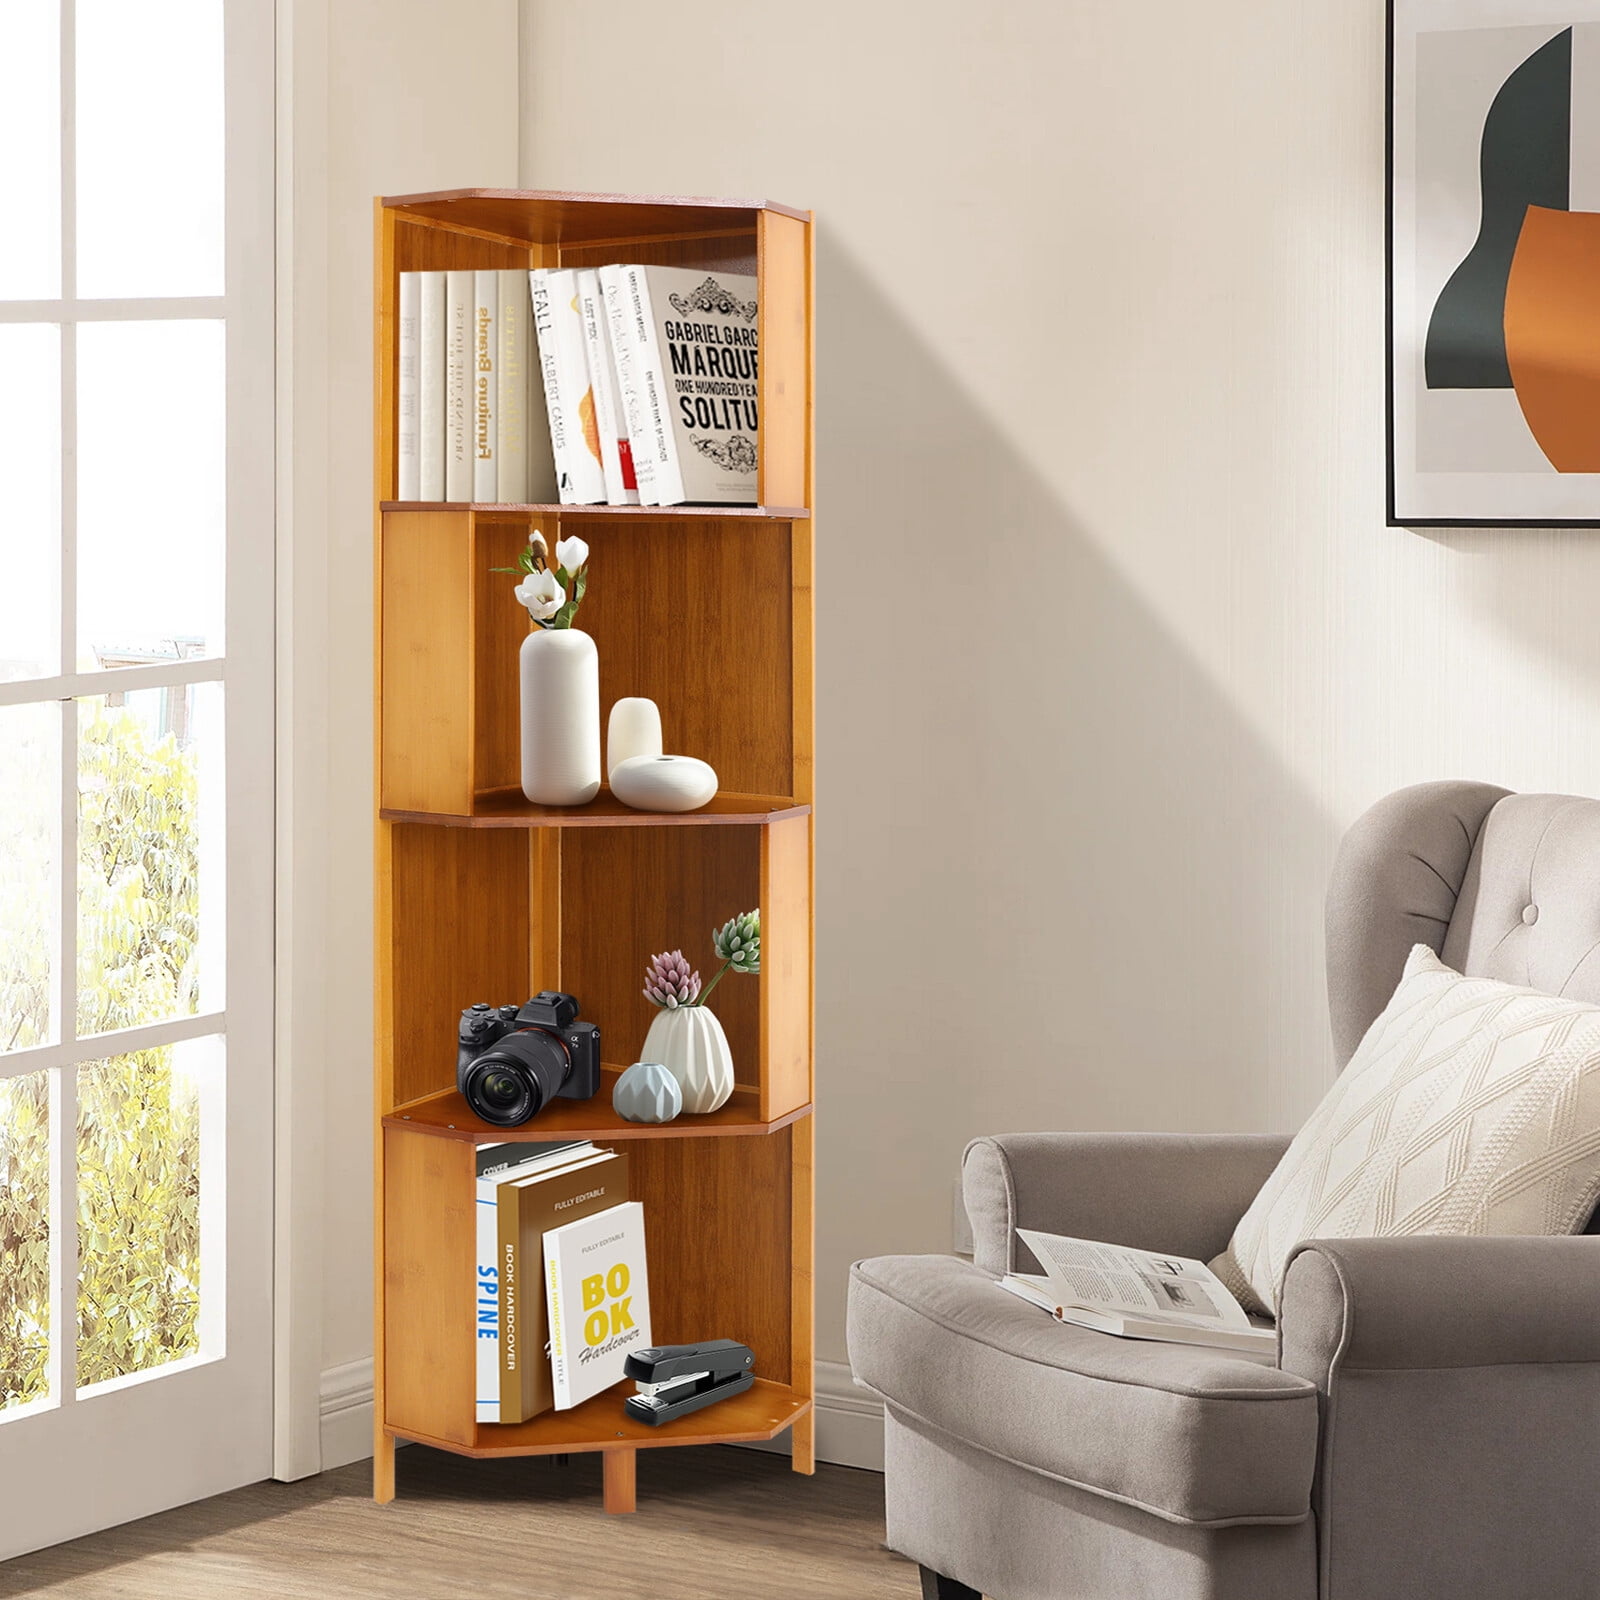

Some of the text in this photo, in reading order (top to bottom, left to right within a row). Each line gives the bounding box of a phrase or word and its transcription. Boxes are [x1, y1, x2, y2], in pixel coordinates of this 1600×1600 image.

[534, 288, 552, 335] FALL
[665, 320, 723, 345] GABRIEL
[544, 353, 566, 449] ALBERT CAMUS
[675, 379, 694, 393] ONE
[695, 381, 739, 396] HUNDRED
[680, 396, 758, 431] SOLITU
[483, 1162, 509, 1176] COVER
[554, 1187, 605, 1212] FULLY EDITABLE
[581, 1232, 625, 1254] FULLY EDITABLE
[478, 1265, 498, 1339] SPINE
[506, 1244, 515, 1371] BOOK HARDCOVER
[581, 1263, 630, 1312] BO
[552, 1292, 563, 1356] HARDCOVER
[584, 1295, 635, 1347] OK
[578, 1329, 640, 1366] Hardcover
